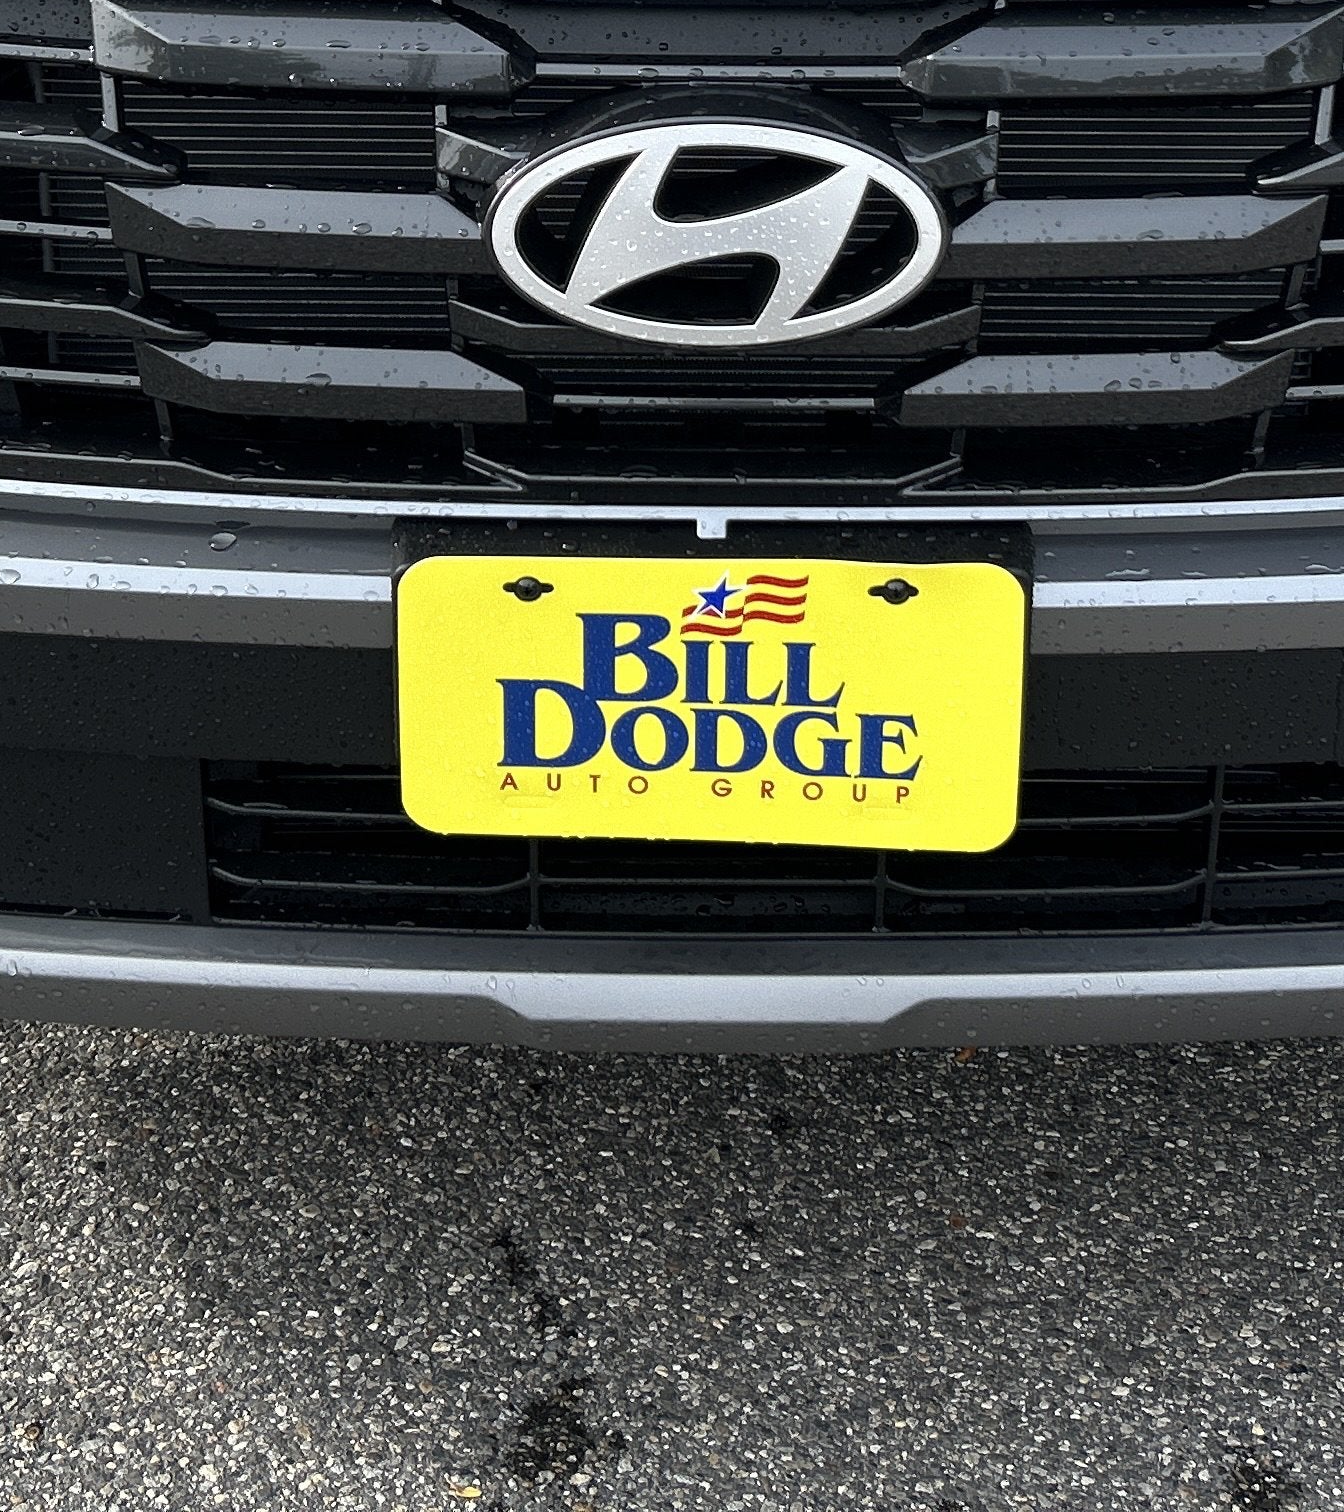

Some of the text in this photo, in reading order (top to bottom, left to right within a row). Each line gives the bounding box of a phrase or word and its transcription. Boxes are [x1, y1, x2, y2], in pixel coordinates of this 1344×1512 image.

[575, 612, 845, 708] BILL
[495, 678, 924, 781] DODGE
[500, 772, 910, 804] AUTO GROUP
